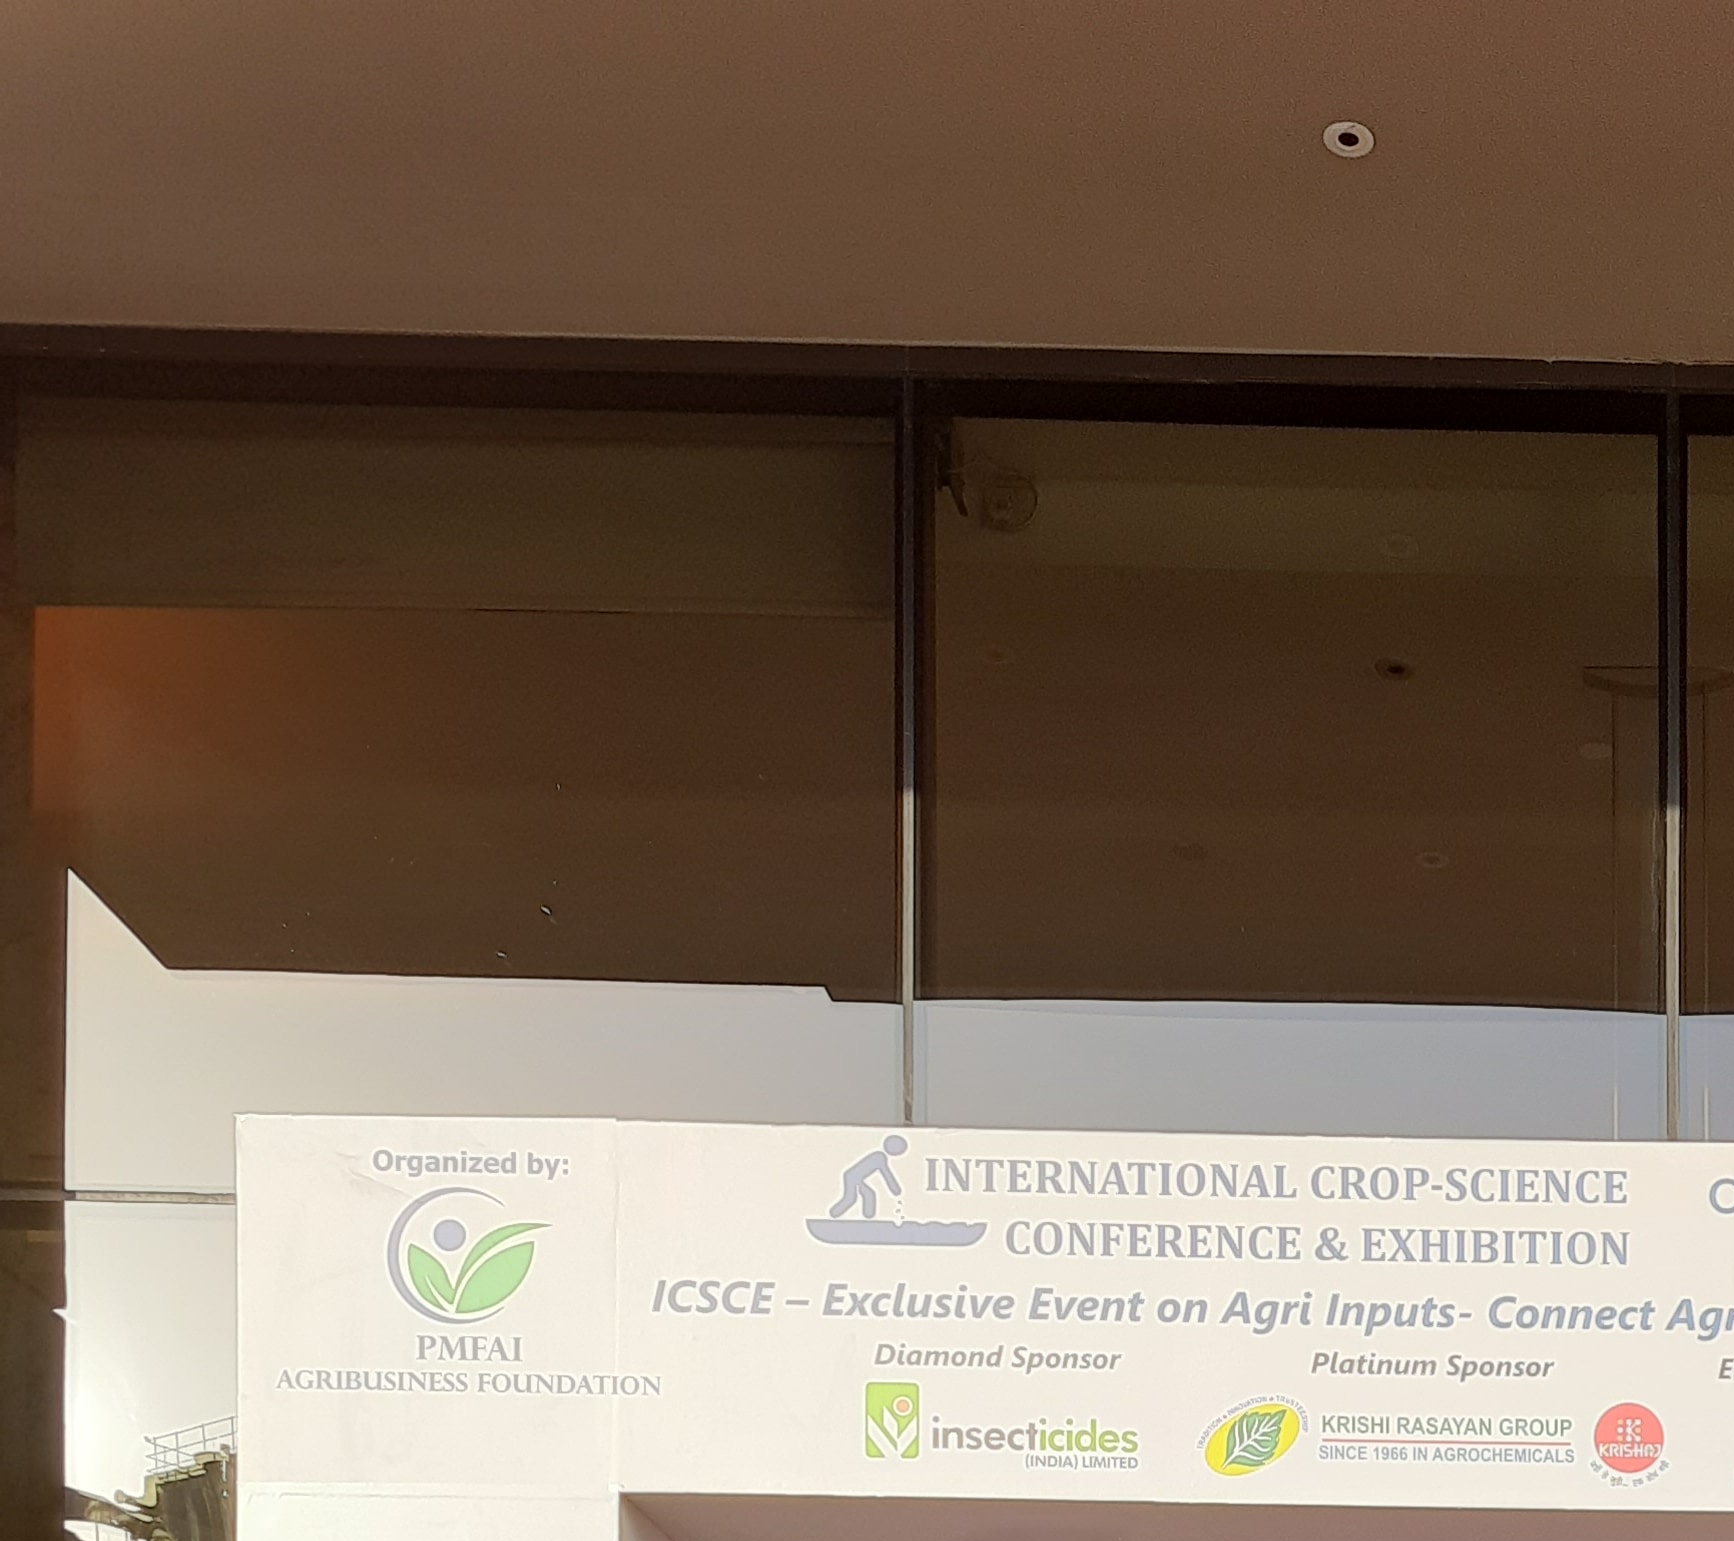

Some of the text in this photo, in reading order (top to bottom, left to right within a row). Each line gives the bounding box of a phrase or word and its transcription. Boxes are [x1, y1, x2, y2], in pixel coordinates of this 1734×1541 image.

[373, 1150, 568, 1180] Organized by:
[926, 1158, 1627, 1203] INTERNATIONAL CROP-SCIENCE
[1006, 1221, 1629, 1265] CONFERENCE & EXHIBITION
[652, 1280, 775, 1314] ICSCE
[823, 1283, 1015, 1319] Exclusive
[1029, 1288, 1145, 1321] Event
[1157, 1299, 1207, 1322] on
[1220, 1292, 1310, 1334] Agri
[1326, 1294, 1472, 1336] Inputs-
[1489, 1296, 1655, 1330] Connect
[416, 1335, 522, 1361] PMFAI
[875, 1343, 1121, 1374] Diamond Sponsor
[1312, 1352, 1554, 1382] Platinum Sponsor
[276, 1370, 660, 1395] AGRIBUSINESS FOUNDATION
[933, 1416, 1138, 1452] insecticides
[1322, 1416, 1572, 1436] KRISHI RASAYAN GROUP
[1026, 1454, 1138, 1470] (INDIA) LIMITED
[1319, 1445, 1574, 1463] SINCE 1966 IN AGROCHEMICALS
